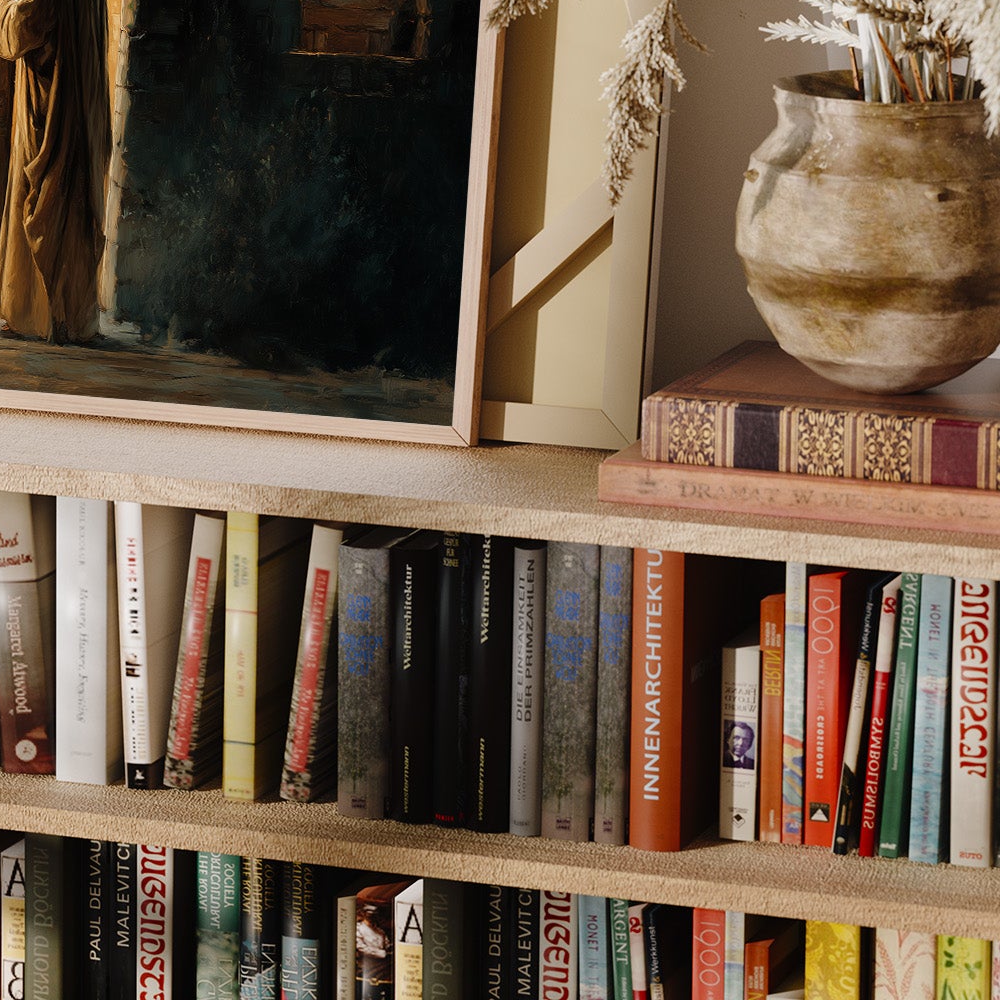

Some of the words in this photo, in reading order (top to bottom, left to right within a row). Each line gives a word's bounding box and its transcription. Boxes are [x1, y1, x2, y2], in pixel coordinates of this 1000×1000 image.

[6, 596, 25, 657] Margaret
[403, 564, 412, 670] Weltarchitektur
[525, 559, 535, 687] PRIMZAHLEN
[12, 660, 30, 714] Atwood
[524, 691, 533, 722] DER
[643, 549, 663, 801] INNENARCHITEKTU
[402, 746, 411, 813] westermann
[477, 738, 486, 821] westermann
[90, 916, 102, 961] PAUL
[588, 913, 599, 952] MONET
[651, 926, 660, 975] Werkkunst
[699, 920, 721, 987] 1900
